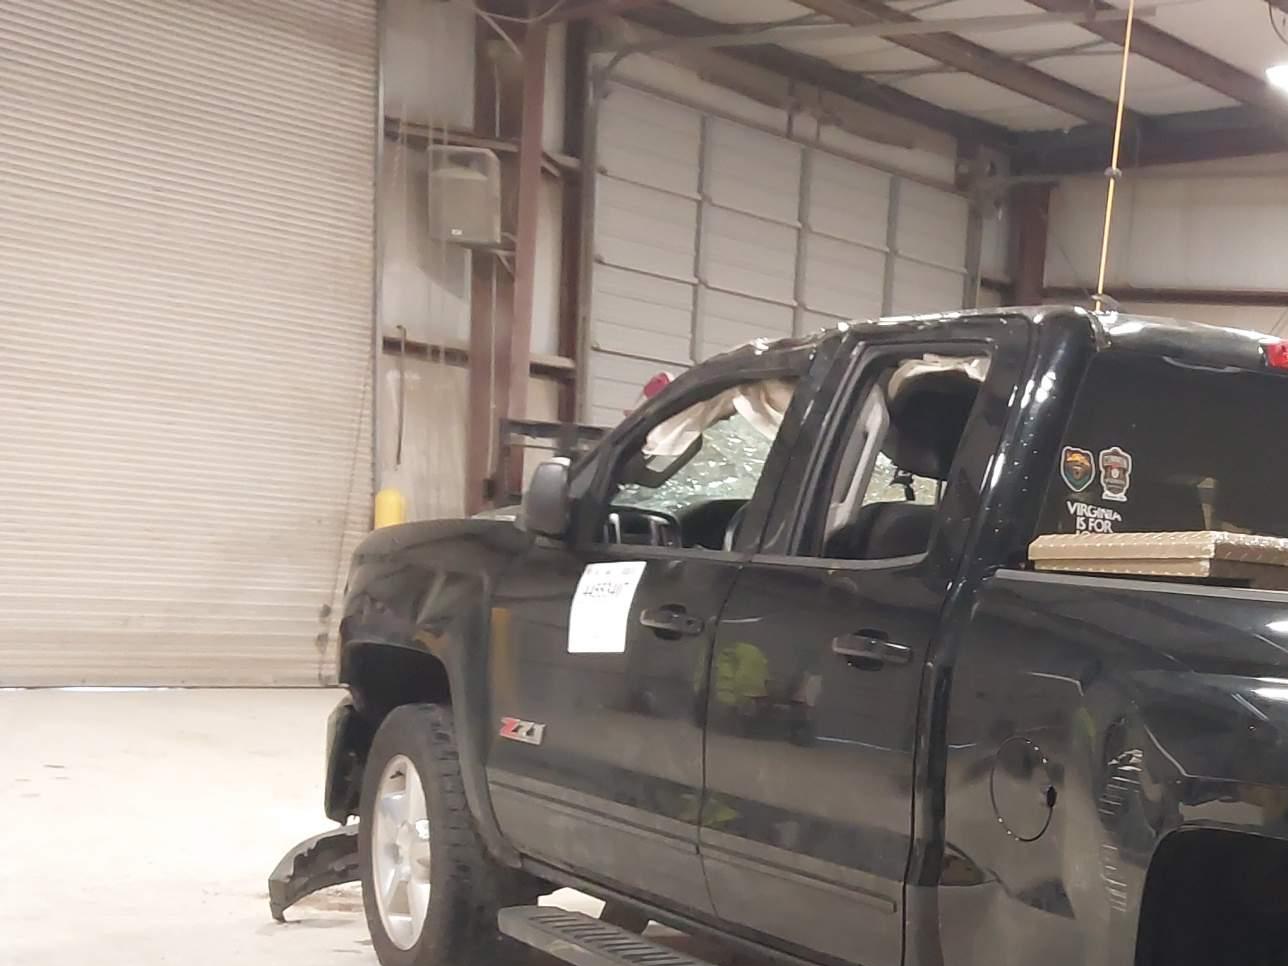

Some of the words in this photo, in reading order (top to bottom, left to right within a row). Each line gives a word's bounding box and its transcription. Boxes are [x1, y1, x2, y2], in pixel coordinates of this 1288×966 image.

[1066, 501, 1122, 521] VIRGINIA
[1076, 516, 1087, 530] IS
[1088, 518, 1113, 533] FOR
[500, 717, 545, 745] Z71
